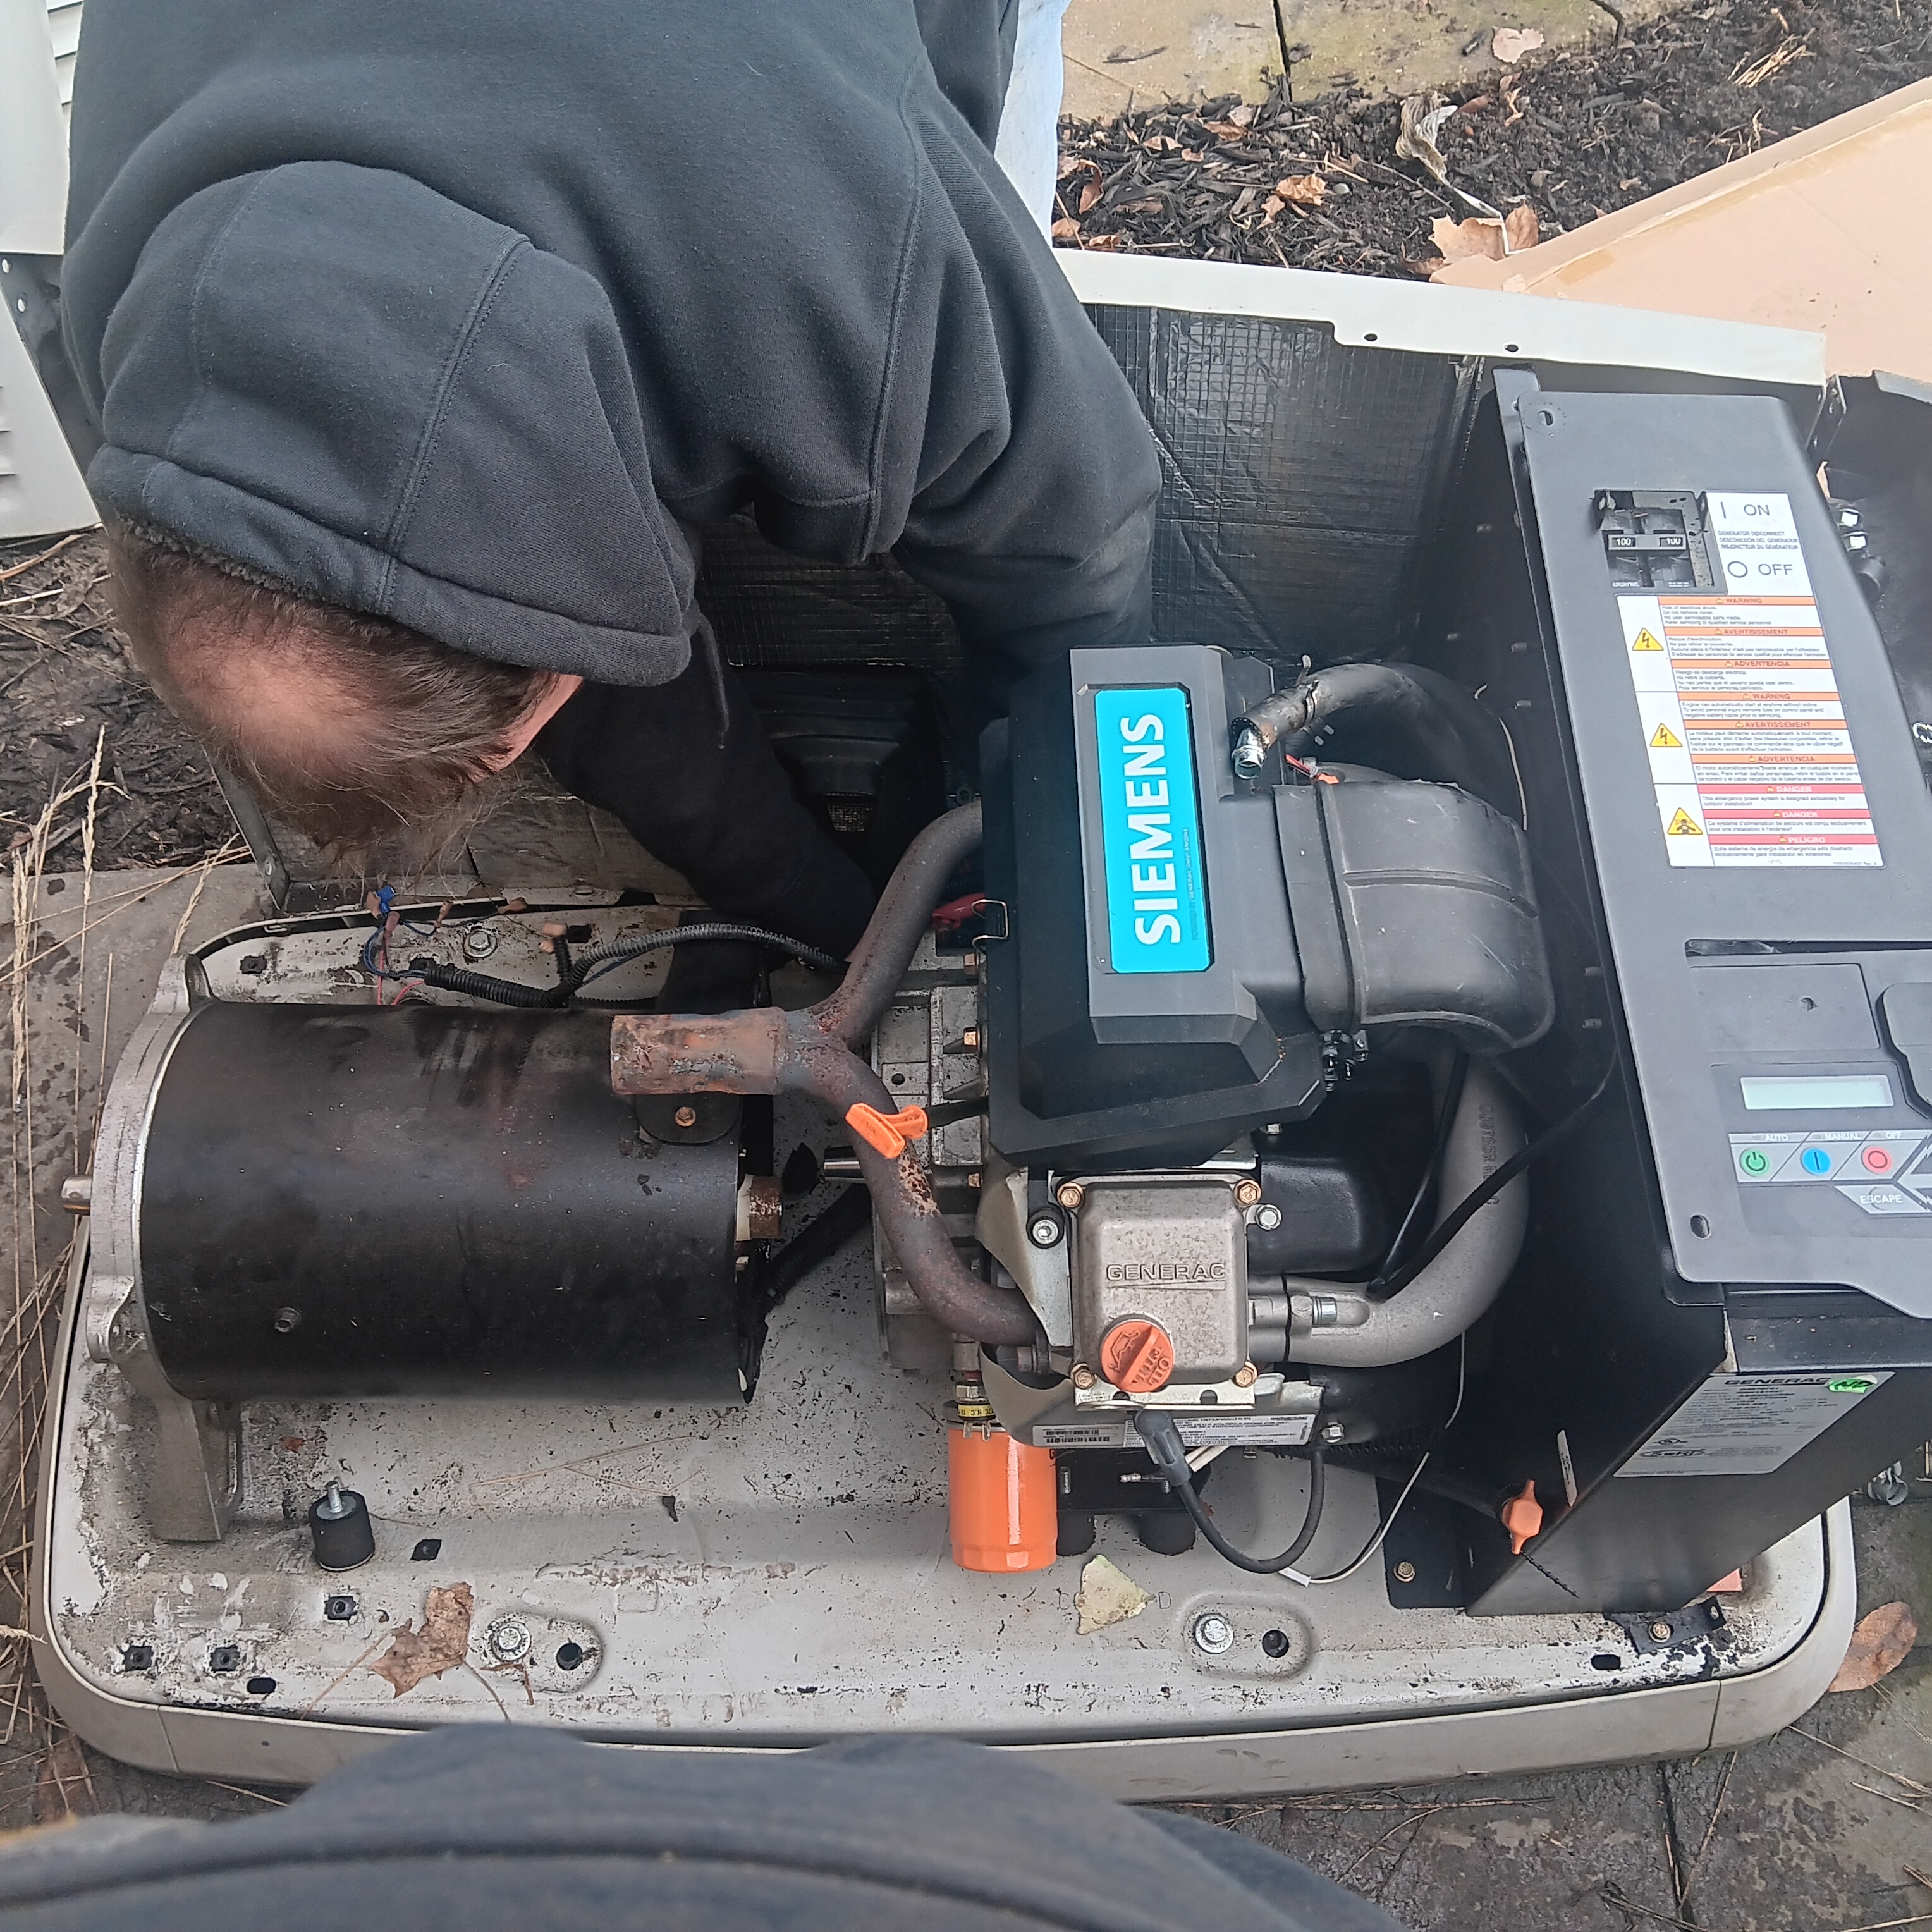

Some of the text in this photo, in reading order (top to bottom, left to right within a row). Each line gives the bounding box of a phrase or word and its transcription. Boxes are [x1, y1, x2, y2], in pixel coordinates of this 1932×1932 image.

[1744, 504, 1771, 516] ON
[1758, 564, 1794, 575] OFF
[1120, 714, 1181, 946] SIEMENS
[1824, 1132, 1861, 1140] MANUAL
[1885, 1131, 1903, 1139] OFF
[1859, 1194, 1903, 1204] ESCAPE
[1106, 1263, 1226, 1281] GENERAC
[1148, 1357, 1170, 1386] OIL
